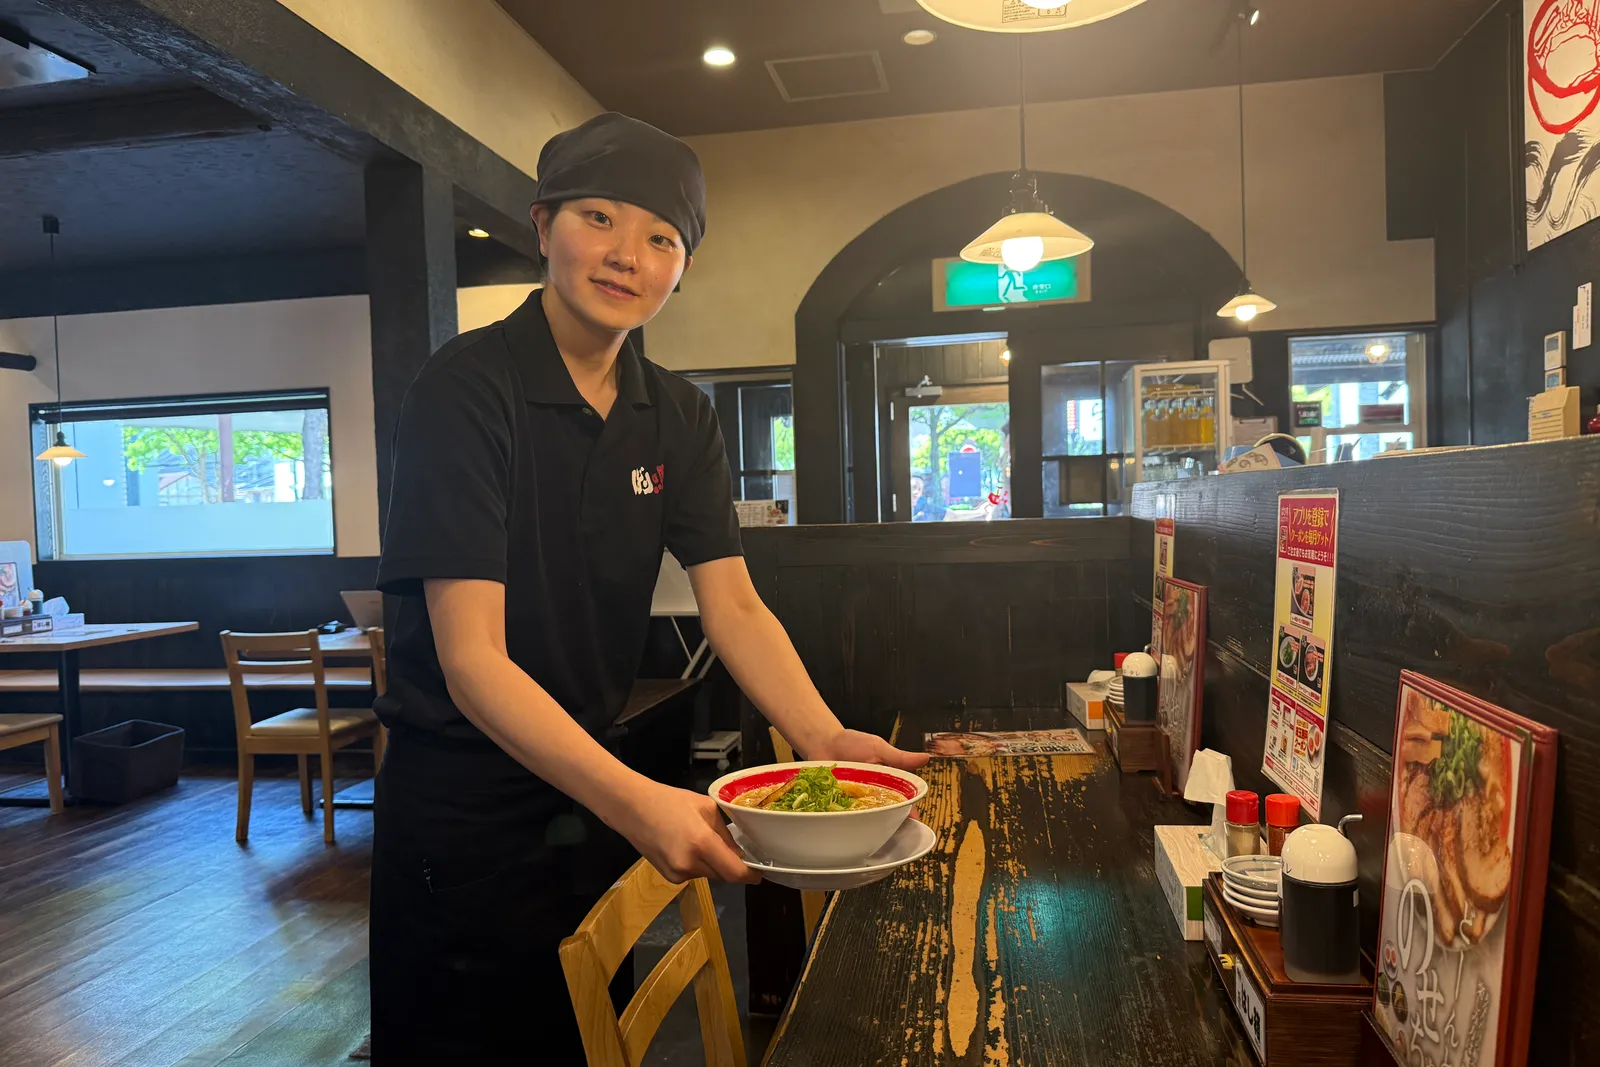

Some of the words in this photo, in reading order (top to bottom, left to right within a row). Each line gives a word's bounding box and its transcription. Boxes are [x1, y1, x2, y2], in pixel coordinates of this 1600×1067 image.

[1292, 506, 1330, 528] アプリを登録で
